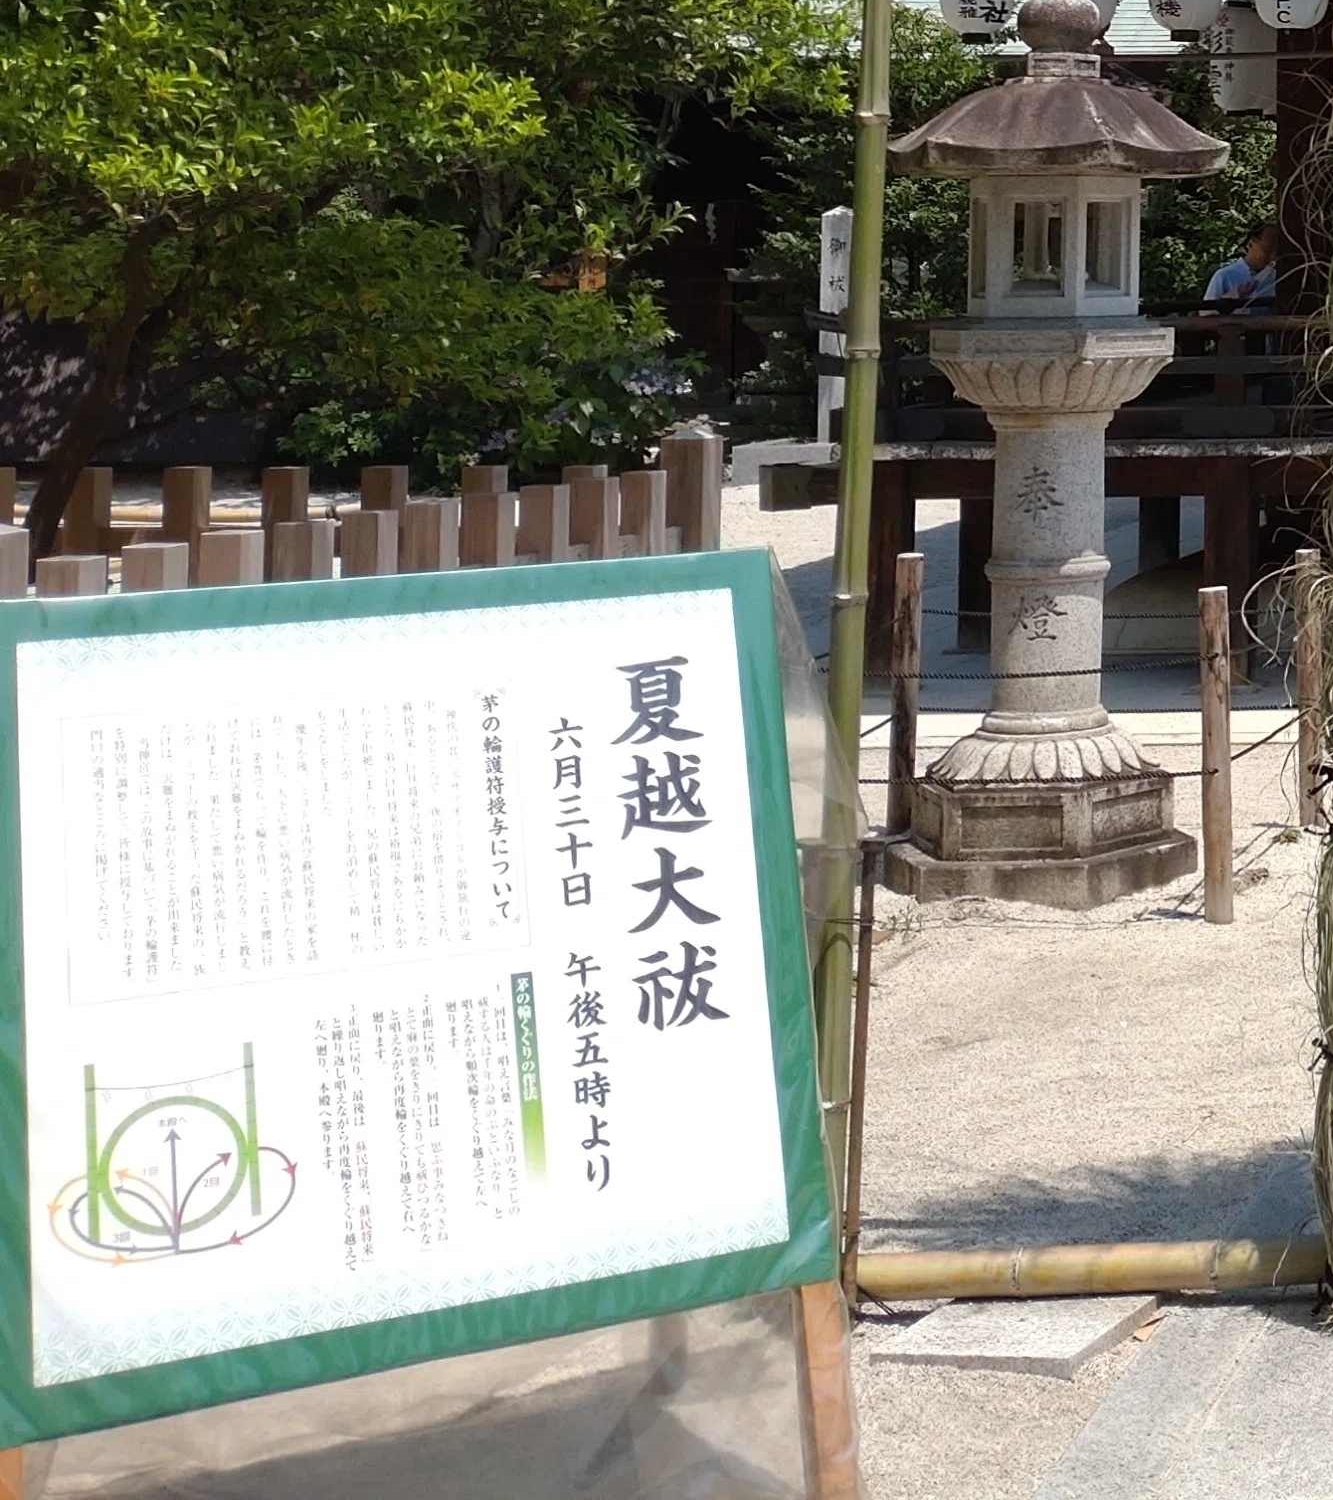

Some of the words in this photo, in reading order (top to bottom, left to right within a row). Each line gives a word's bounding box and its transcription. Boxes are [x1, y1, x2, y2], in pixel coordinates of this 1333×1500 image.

[1008, 465, 1068, 641] 奉燈
[481, 693, 513, 920] 茅の輪護符授与について
[548, 717, 602, 906] 六月三十日
[610, 655, 731, 1032] 夏越大祓
[515, 977, 537, 1102] 茅の輪くぐりの作法
[563, 952, 612, 1192] 午後五時より
[112, 1231, 131, 1244] 3回
[203, 1176, 221, 1189] 2回
